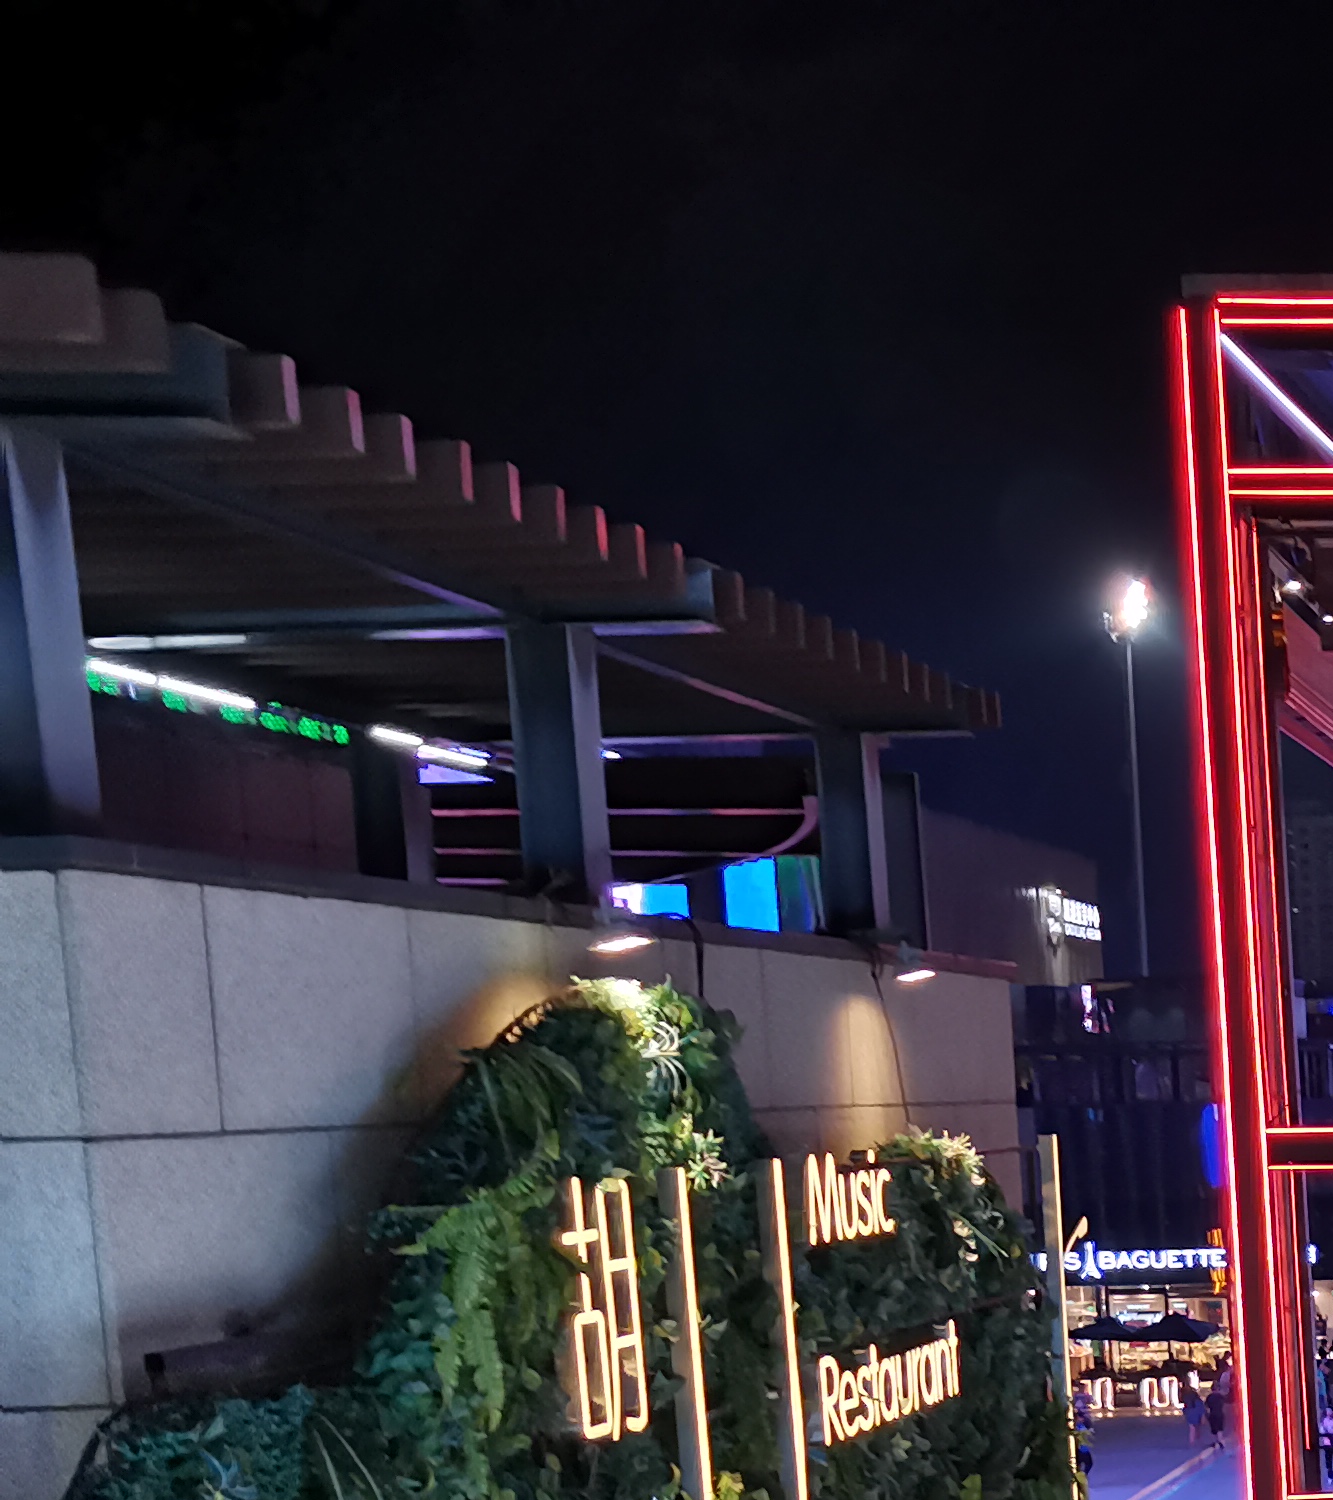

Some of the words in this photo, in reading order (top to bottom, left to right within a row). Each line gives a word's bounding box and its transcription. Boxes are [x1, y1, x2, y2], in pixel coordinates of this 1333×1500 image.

[805, 1151, 897, 1246] Music
[1097, 1248, 1228, 1271] BAGUETTE
[817, 1319, 961, 1446] Restaurant
